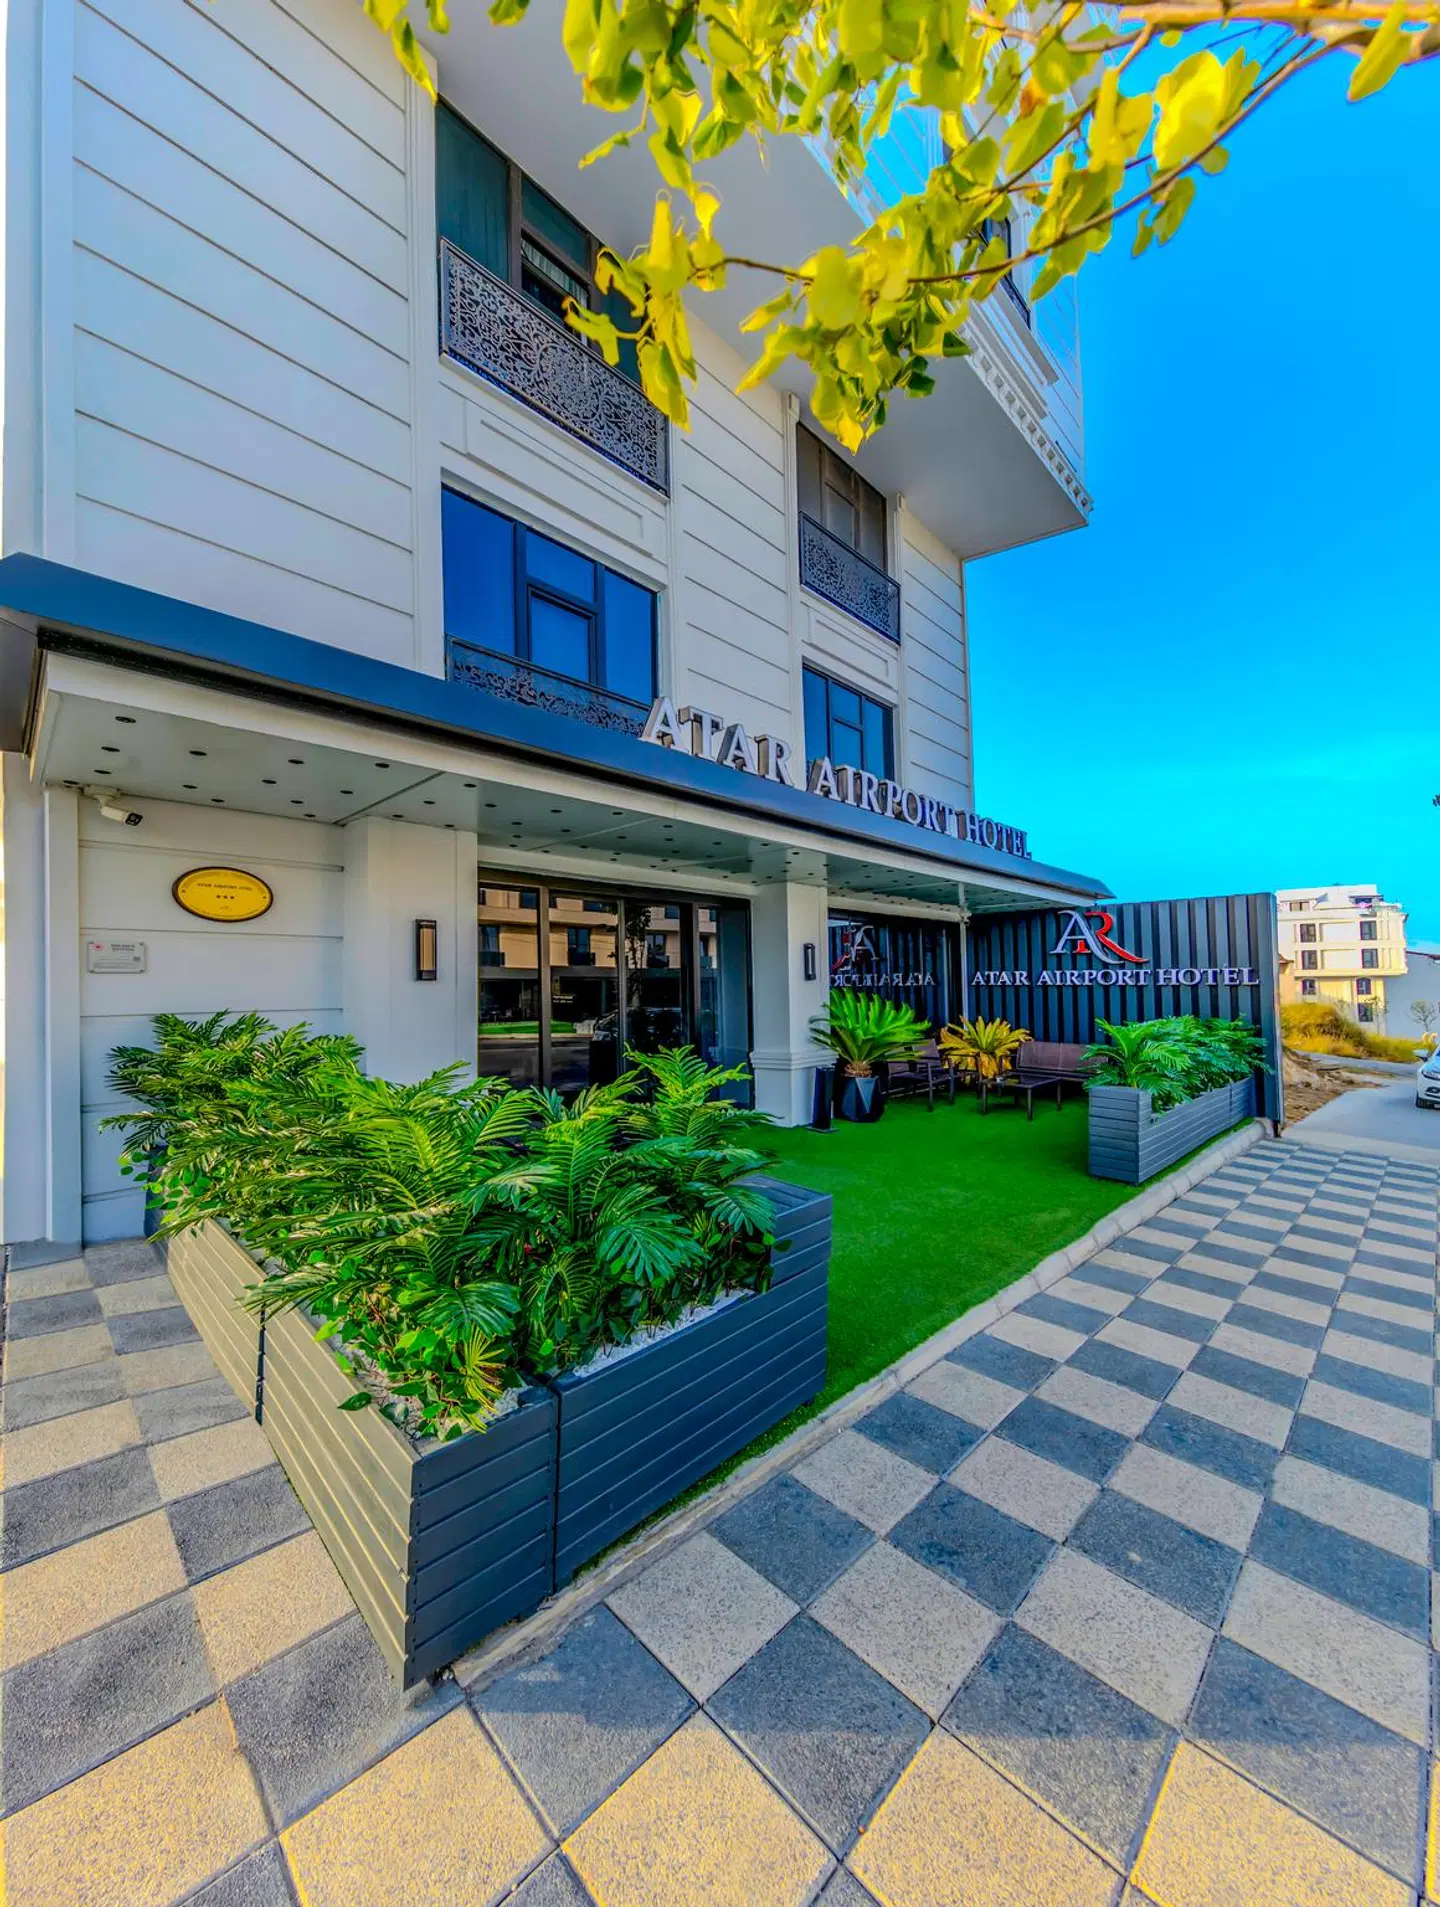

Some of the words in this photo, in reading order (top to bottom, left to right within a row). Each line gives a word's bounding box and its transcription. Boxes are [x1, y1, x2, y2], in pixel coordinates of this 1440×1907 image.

[638, 696, 807, 791] ATAR
[809, 756, 958, 839] AIRPORT
[961, 811, 1032, 860] HOTEL
[971, 970, 1030, 986] ATAR
[1036, 969, 1150, 986] AIRPORT
[1156, 967, 1259, 986] HOTEL
